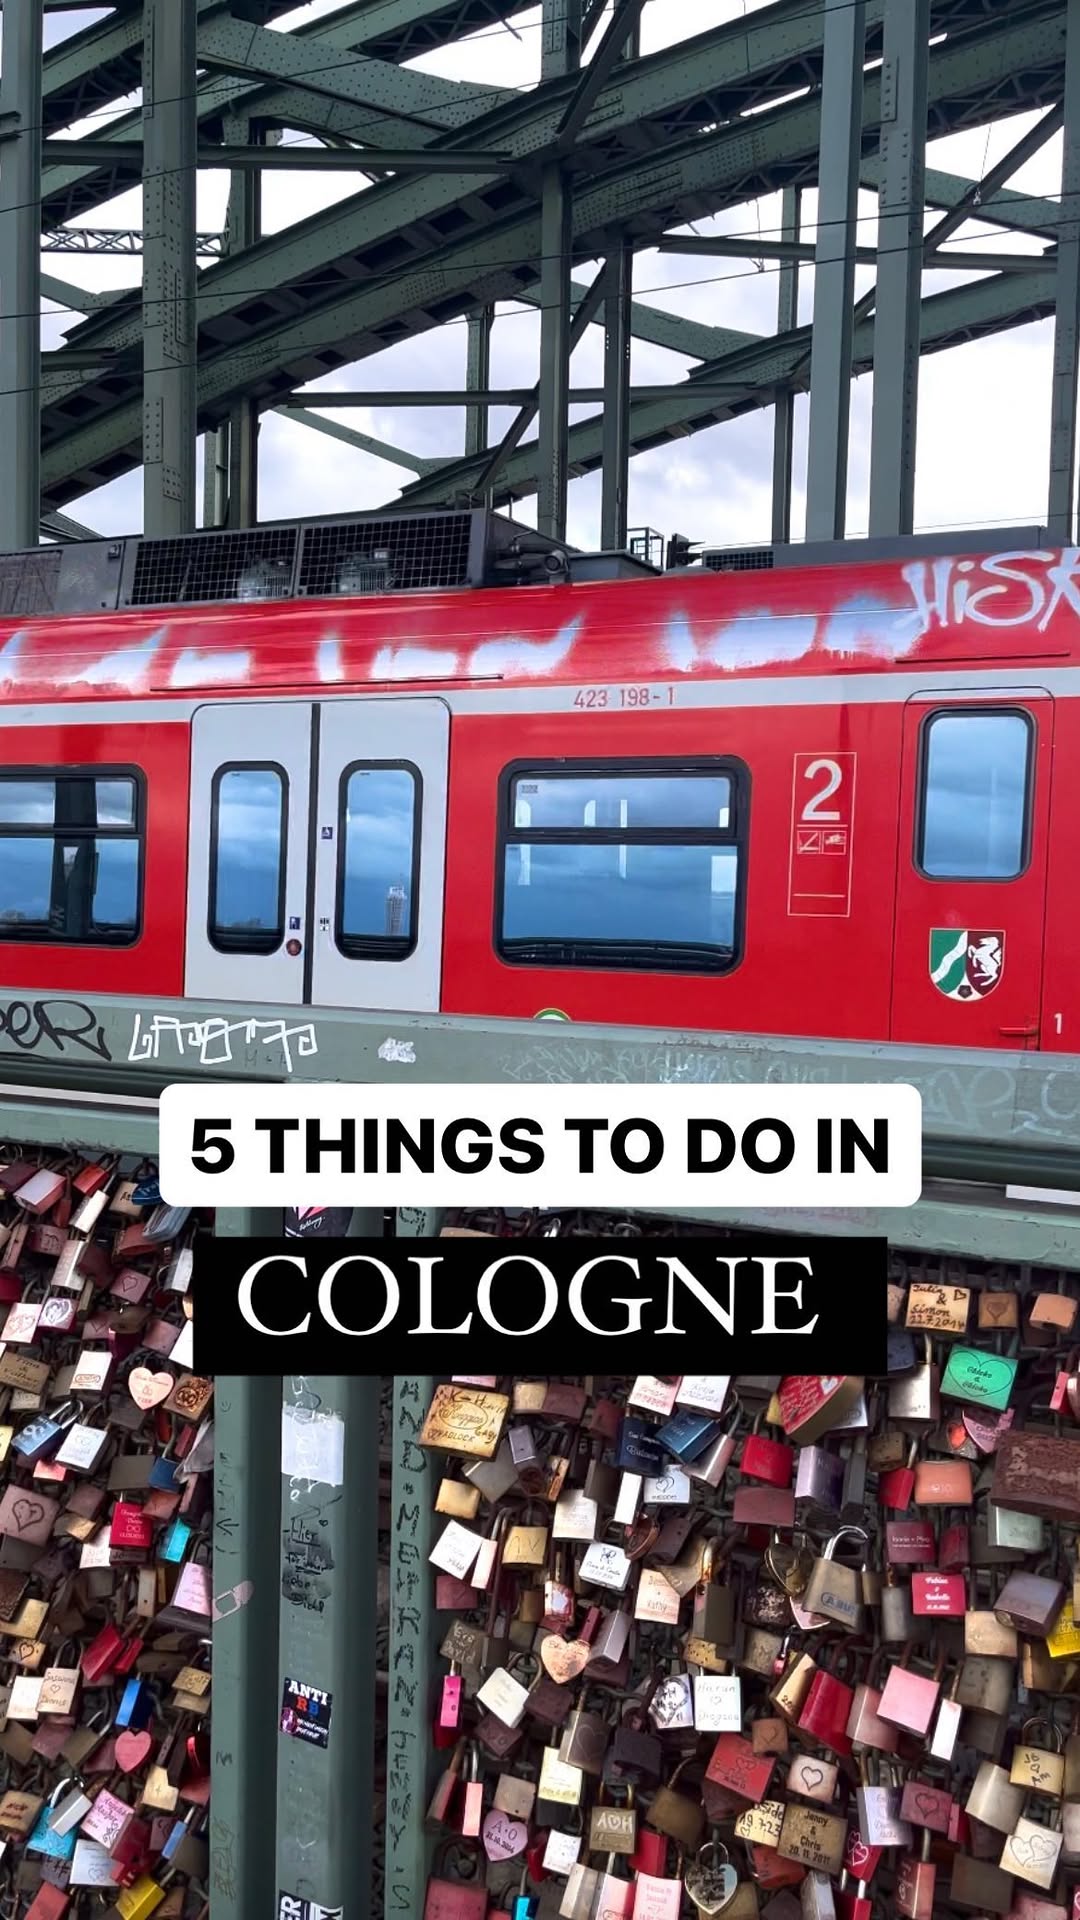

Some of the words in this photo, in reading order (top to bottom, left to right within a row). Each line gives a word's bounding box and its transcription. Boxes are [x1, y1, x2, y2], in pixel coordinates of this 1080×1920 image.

[574, 689, 608, 708] 423
[801, 759, 841, 821] 2
[1054, 1013, 1063, 1034] 1
[288, 1680, 328, 1706] ANTI
[800, 1835, 821, 1851] Chris
